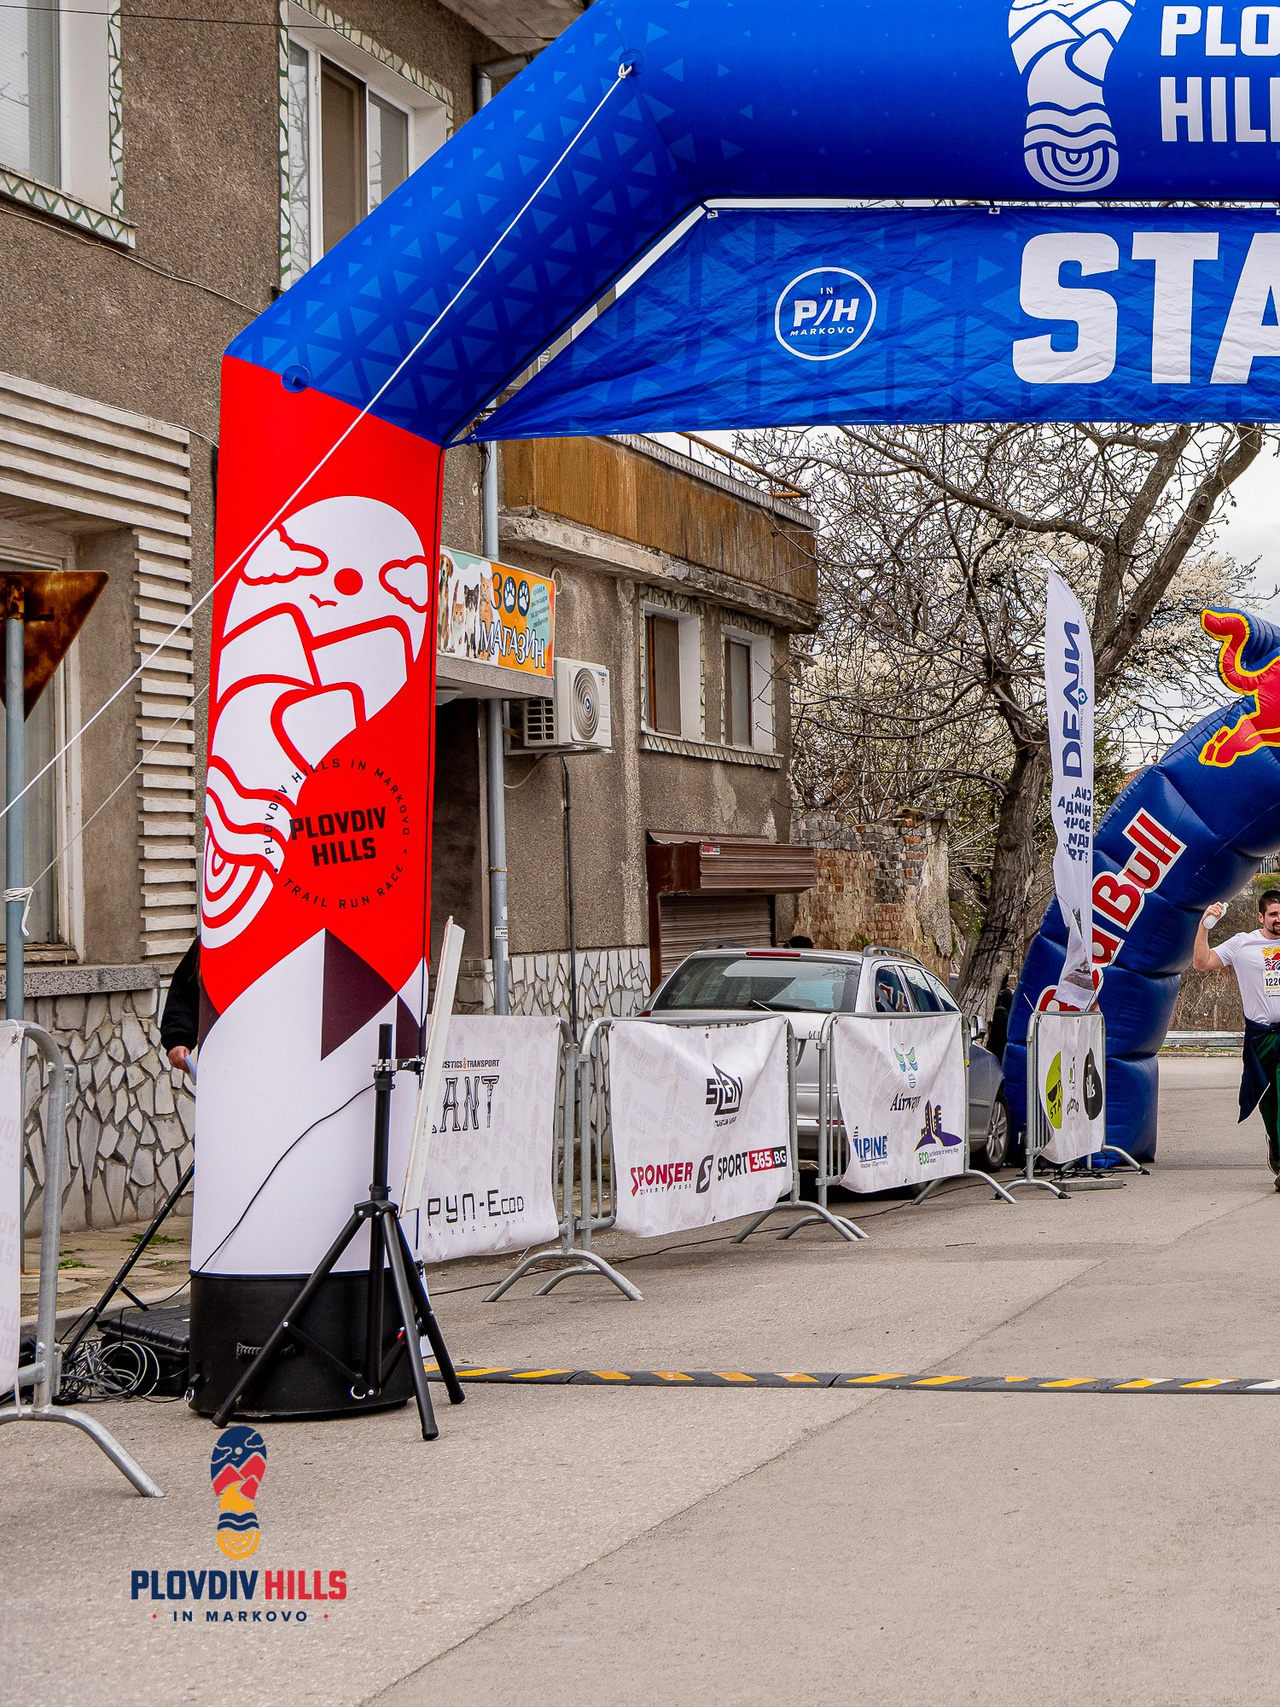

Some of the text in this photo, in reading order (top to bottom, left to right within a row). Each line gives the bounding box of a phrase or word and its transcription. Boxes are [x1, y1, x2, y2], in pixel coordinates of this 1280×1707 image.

[820, 286, 834, 295] IN
[793, 298, 860, 327] P/H
[789, 326, 855, 337] MARKOVO
[490, 571, 531, 617] ЗОО
[479, 619, 546, 669] МАГАЗИН
[264, 758, 410, 856] PLOVDIV HILLS IN MARKOVO
[289, 806, 387, 841] PLOVDIV
[311, 837, 377, 867] HILLS
[1091, 810, 1184, 929] Bull
[284, 864, 404, 909] TRAIL RUN RACE
[630, 1161, 694, 1197] SPONSER
